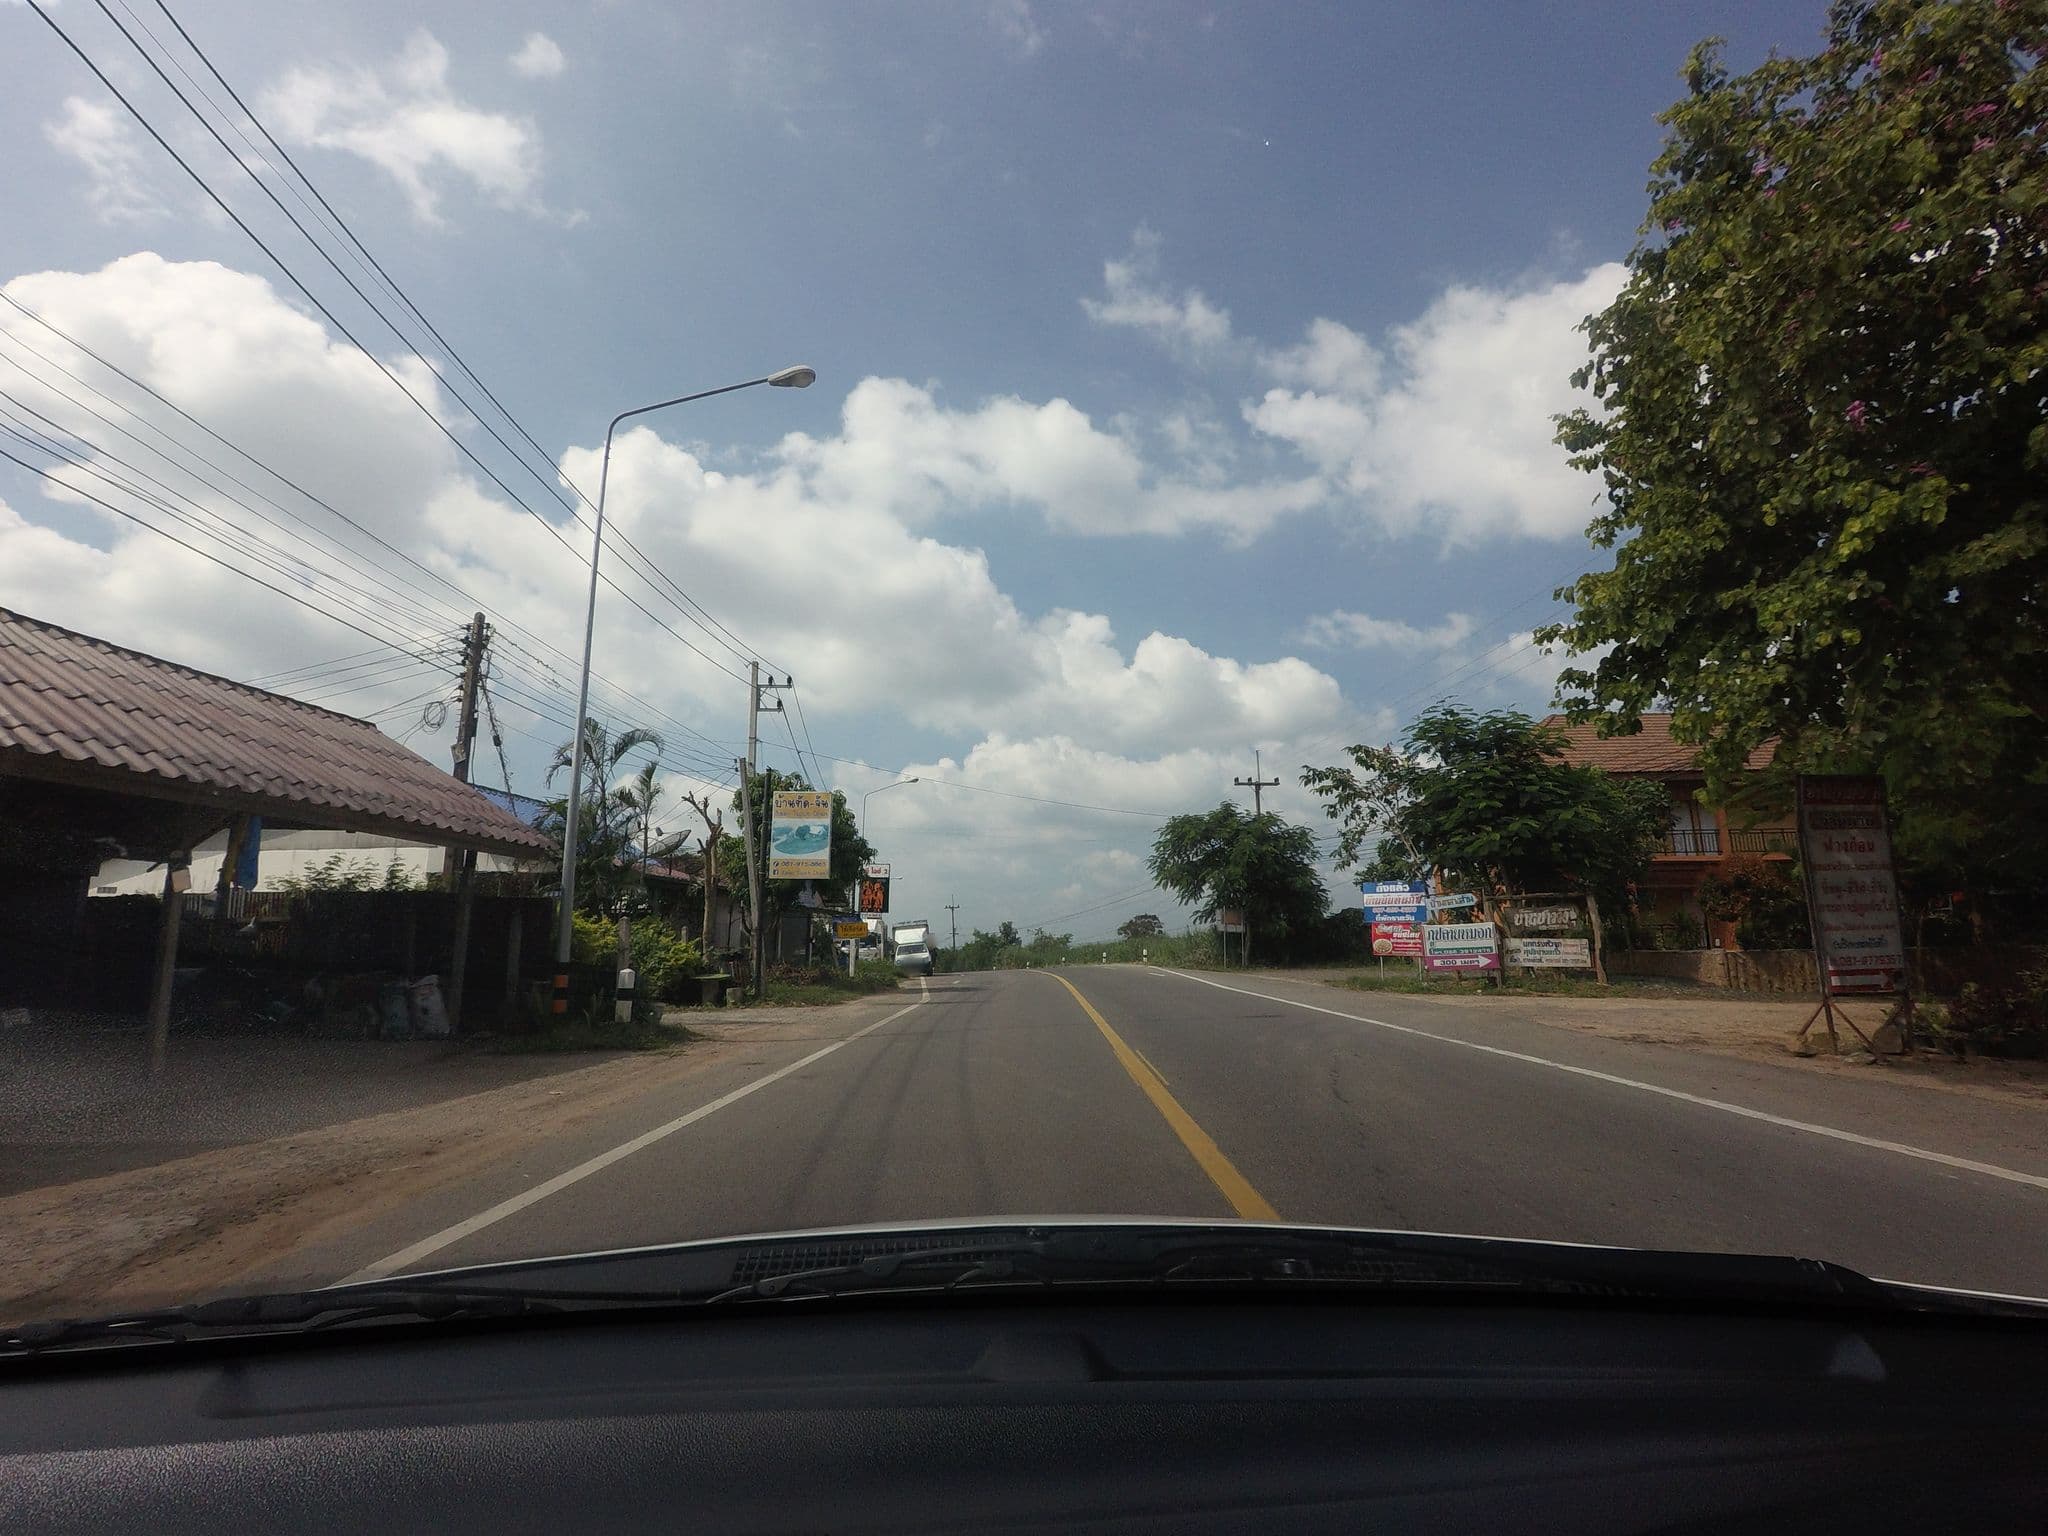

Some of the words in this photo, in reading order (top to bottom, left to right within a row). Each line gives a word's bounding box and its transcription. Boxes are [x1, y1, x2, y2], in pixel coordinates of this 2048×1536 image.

[1375, 913, 1415, 921] ที่พักรายวัน
